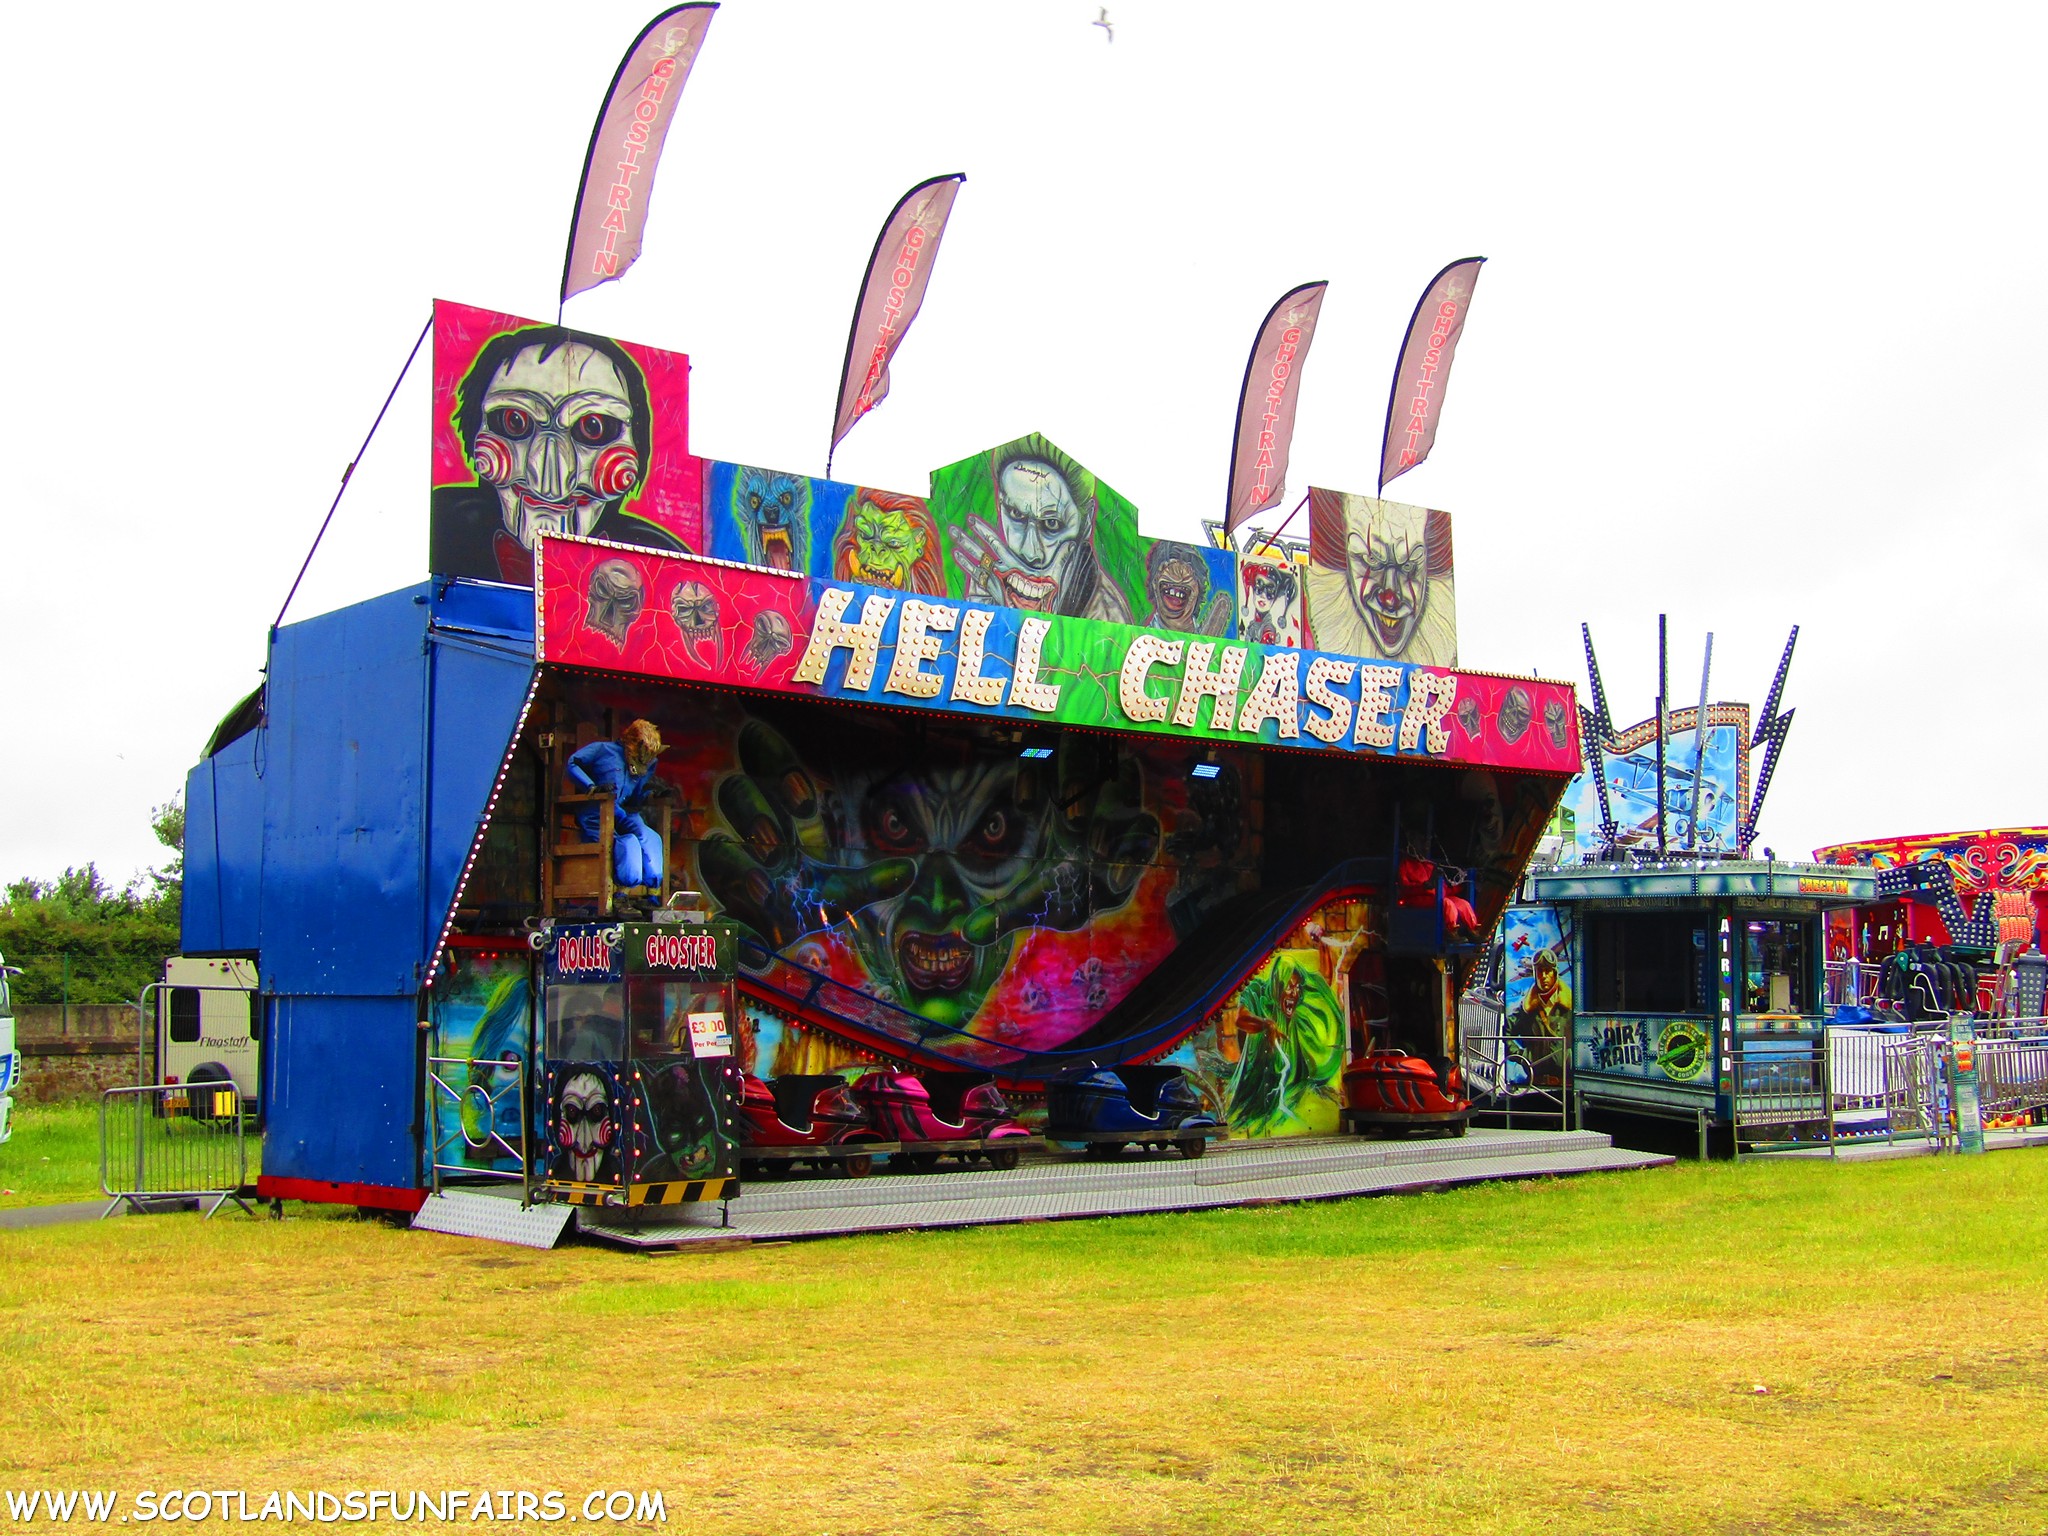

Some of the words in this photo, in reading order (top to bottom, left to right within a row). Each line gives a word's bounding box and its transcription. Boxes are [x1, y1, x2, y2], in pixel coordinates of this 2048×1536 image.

[792, 588, 1062, 713] HELL
[1119, 633, 1457, 755] CHASER
[1798, 877, 1834, 893] CHECK
[1835, 879, 1848, 894] IN
[558, 936, 610, 972] ROLLER
[645, 934, 717, 969] GHOSTER
[1720, 918, 1730, 973] AIR
[199, 1035, 250, 1048] Flagstaff
[1604, 1025, 1635, 1047] AIR
[1721, 997, 1731, 1071] RAID
[1599, 1045, 1643, 1070] RAID
